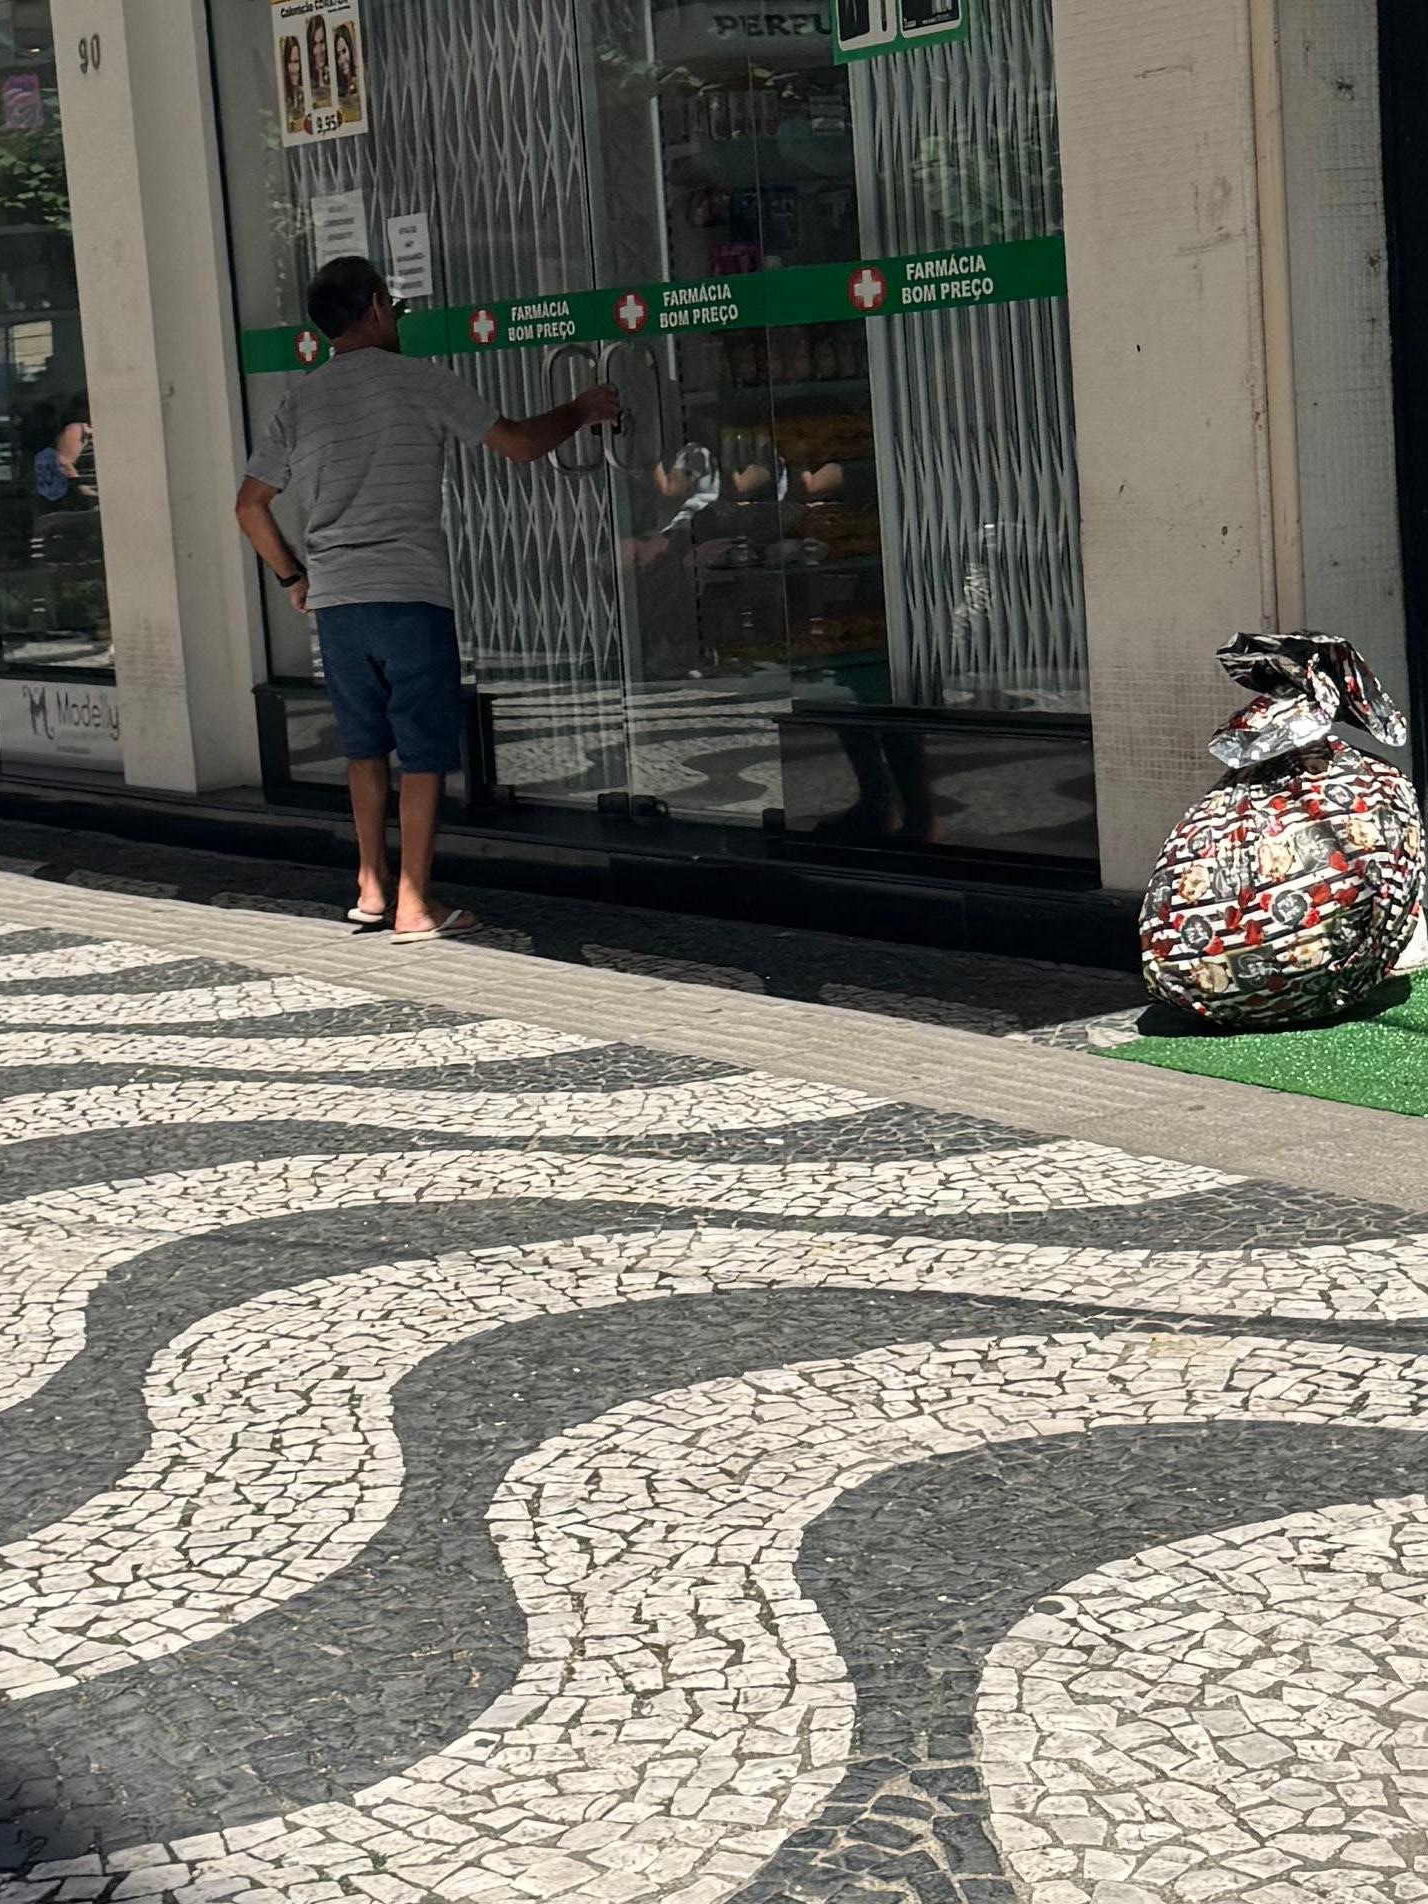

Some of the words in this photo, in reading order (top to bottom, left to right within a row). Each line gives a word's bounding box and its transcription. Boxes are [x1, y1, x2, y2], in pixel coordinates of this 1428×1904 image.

[78, 32, 101, 74] 90
[905, 252, 987, 283] FARMÁCIA
[663, 283, 732, 307] FARMÁCIA
[900, 280, 936, 304] BOM
[940, 276, 994, 306] PREÇO
[510, 299, 570, 323] FARMÁCIA
[659, 310, 690, 329] BOM
[693, 304, 739, 325] PREÇO
[507, 322, 537, 341] BOM
[537, 318, 576, 343] PREÇO
